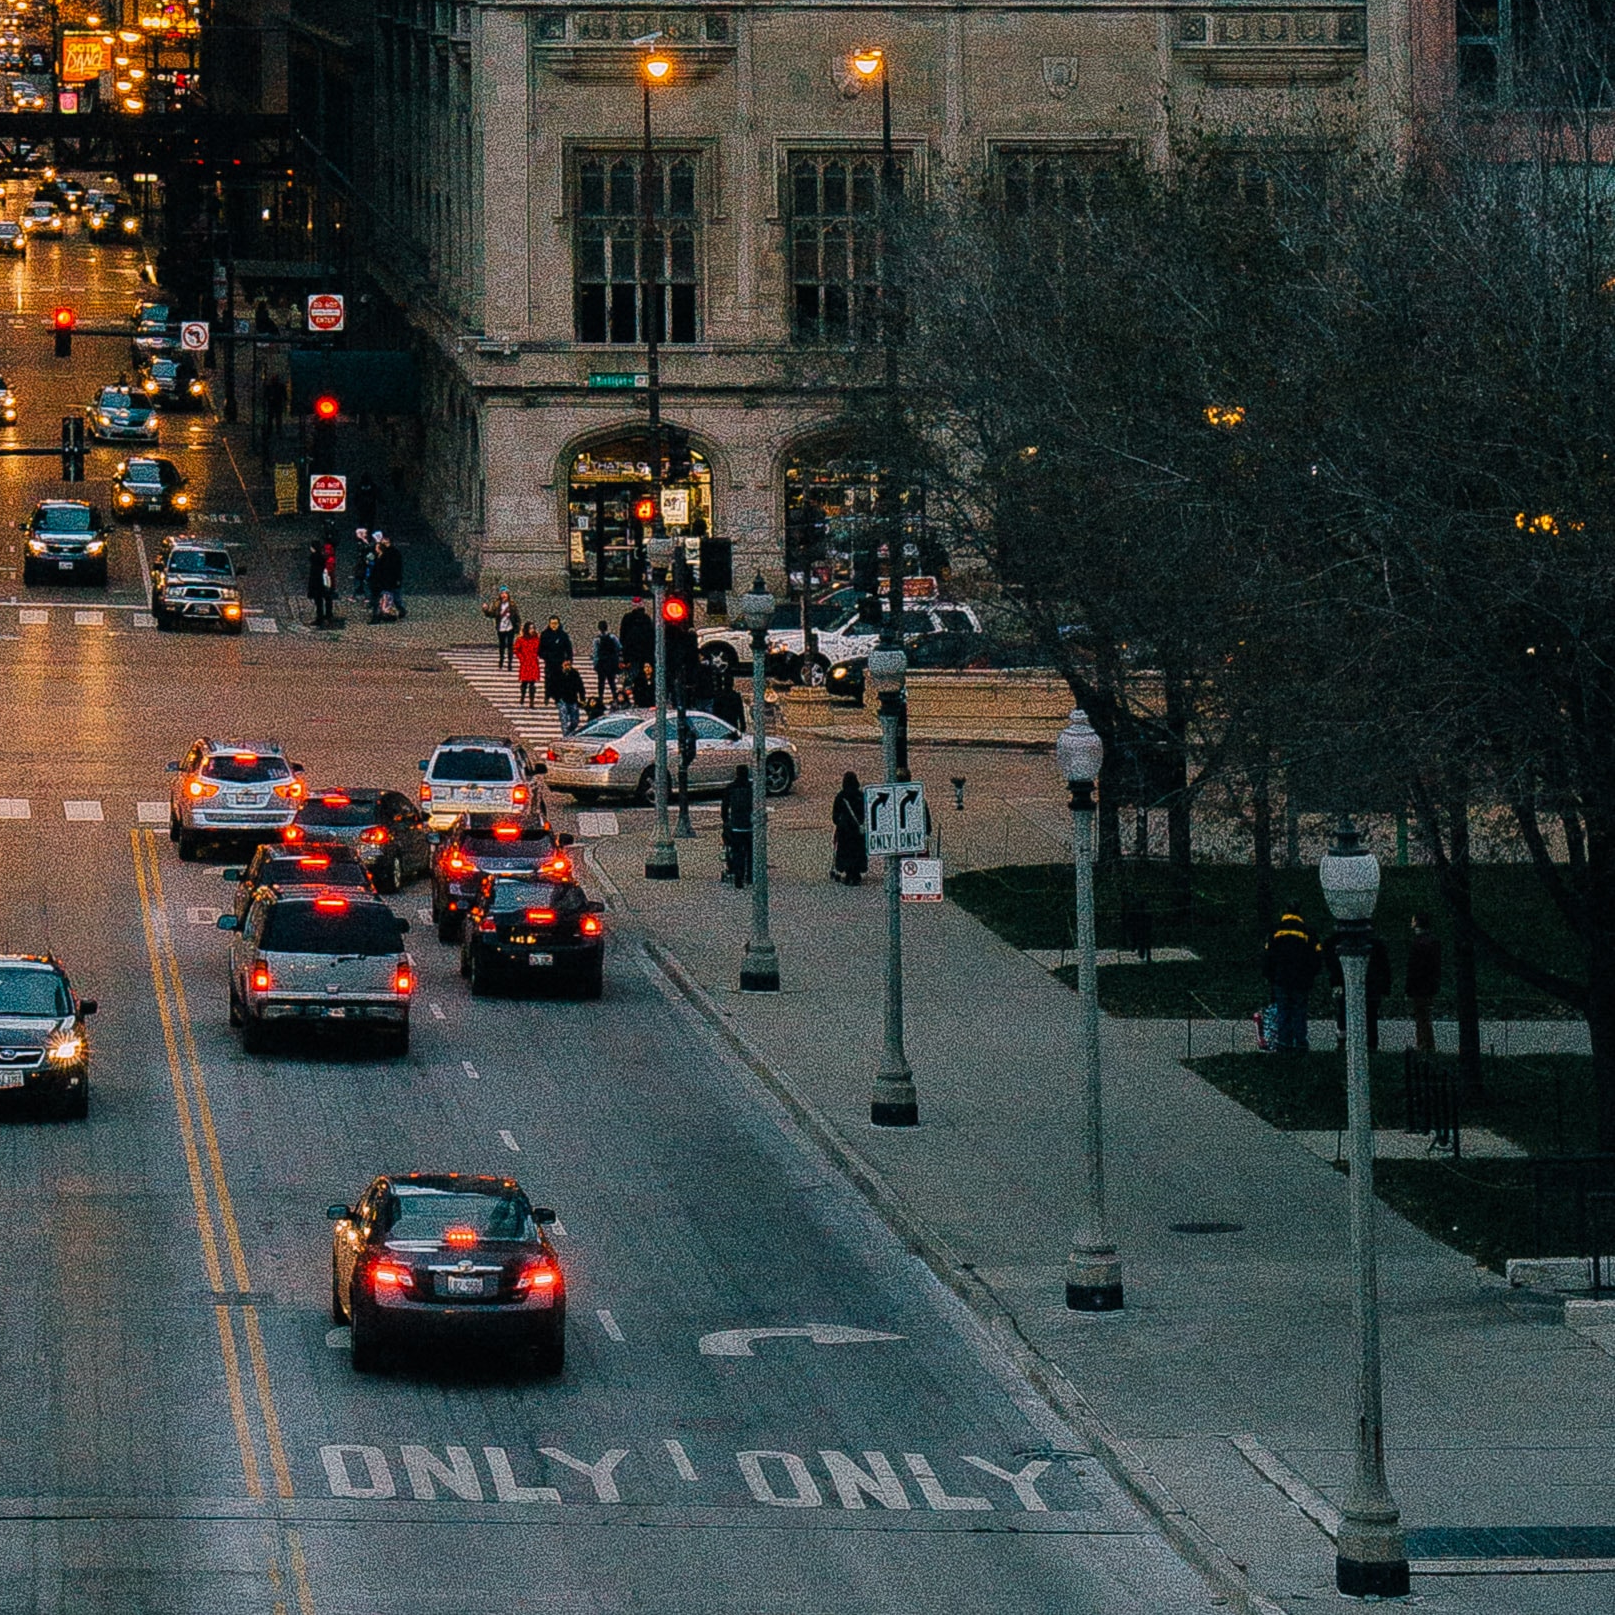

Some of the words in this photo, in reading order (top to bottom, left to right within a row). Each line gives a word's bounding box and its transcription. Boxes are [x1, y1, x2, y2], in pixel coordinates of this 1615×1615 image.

[315, 316, 335, 324] ENTER
[327, 481, 341, 489] NOT
[317, 497, 338, 505] ENTER
[869, 833, 894, 850] ONLY
[899, 831, 923, 848] ONLY
[318, 1443, 630, 1505] ONLY
[735, 1449, 1053, 1513] ONLY
